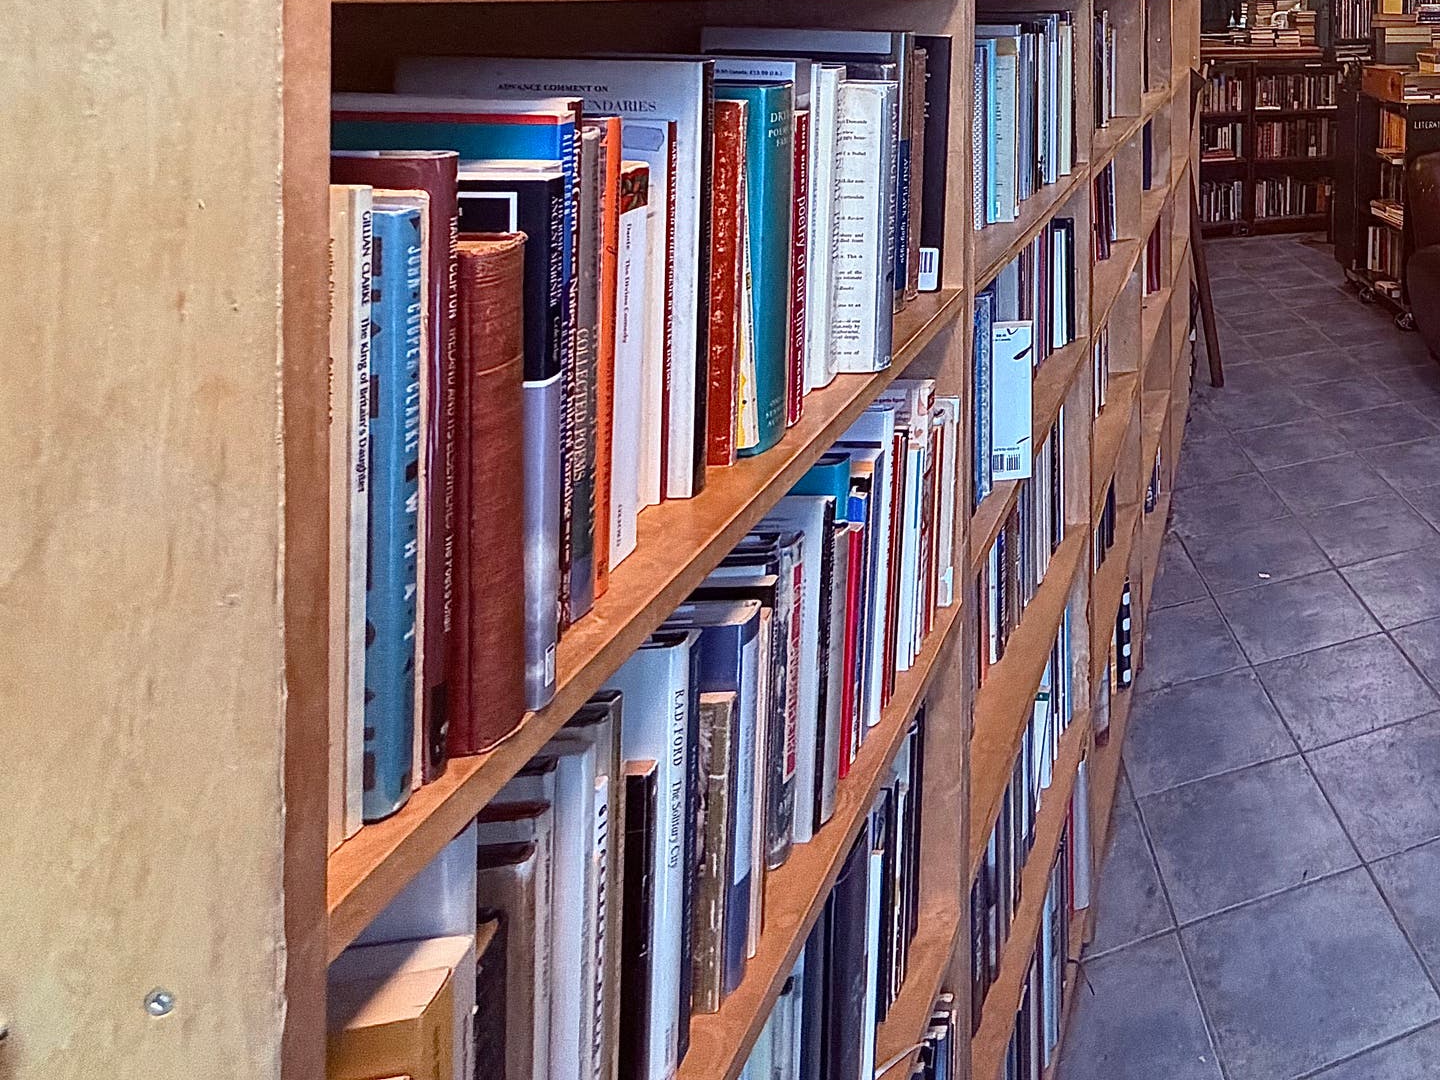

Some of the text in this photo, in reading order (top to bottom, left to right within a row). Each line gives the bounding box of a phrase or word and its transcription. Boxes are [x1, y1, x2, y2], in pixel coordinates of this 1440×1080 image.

[543, 83, 594, 93] COMMENT
[594, 84, 609, 93] ON
[573, 128, 582, 183] Alfred
[570, 185, 581, 232] Corn
[888, 102, 898, 266] LAWRENCE DURRELL
[797, 196, 807, 248] poetry
[550, 196, 560, 308] ANCIENT MARINER
[796, 253, 806, 271] of
[449, 263, 460, 320] CLIFTON
[568, 276, 579, 327] Notes
[623, 279, 631, 307] Divine
[797, 275, 806, 302] our
[405, 245, 420, 454] JOHN COOPER CLARKE
[567, 328, 577, 368] from
[622, 307, 630, 345] Comedy
[794, 308, 805, 347] time
[354, 211, 372, 494] GILLIAN CLARKE The King of Britain's Daughter
[565, 381, 577, 428] Child
[573, 327, 589, 483] COLLECTED POEMS
[563, 448, 576, 520] Paradise
[668, 728, 685, 870] FORD The Solitary City
